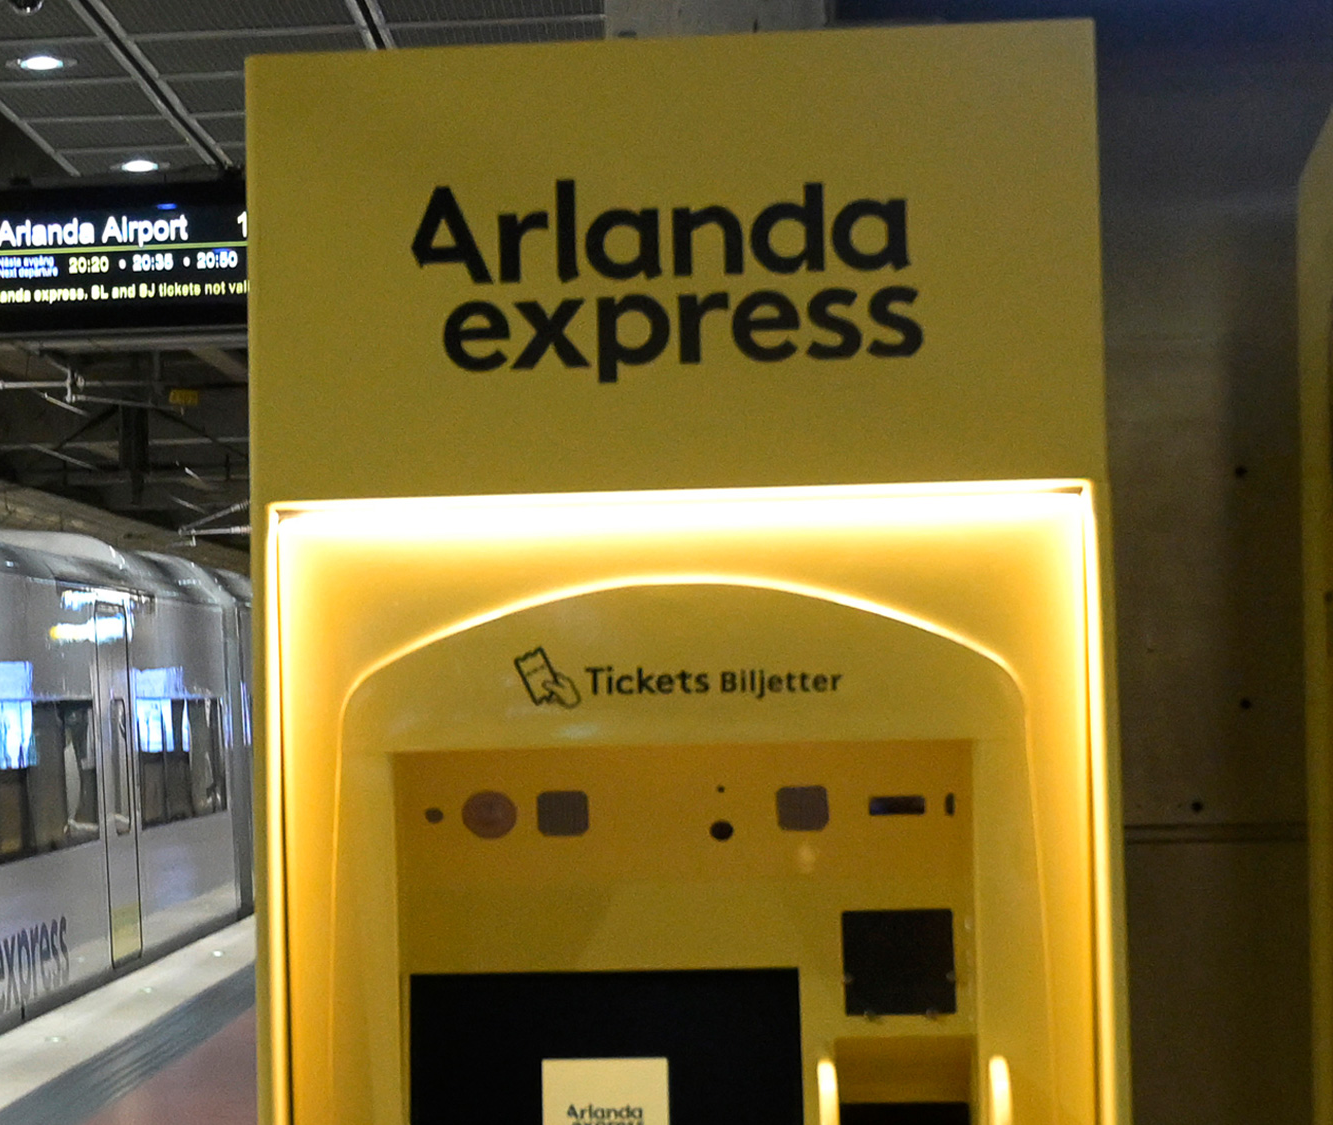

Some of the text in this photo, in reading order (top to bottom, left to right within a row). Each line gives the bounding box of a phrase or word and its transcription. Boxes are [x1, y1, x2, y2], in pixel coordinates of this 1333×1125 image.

[101, 214, 189, 248] Airport
[411, 179, 911, 286] Arlanda
[68, 251, 238, 274] 20:20 20:35 20:50
[111, 283, 136, 300] and
[158, 281, 202, 298] tickets
[204, 280, 226, 296] not
[443, 285, 925, 384] express
[585, 666, 844, 700] Tickets Biljetter
[567, 1103, 644, 1120] Arlanda
